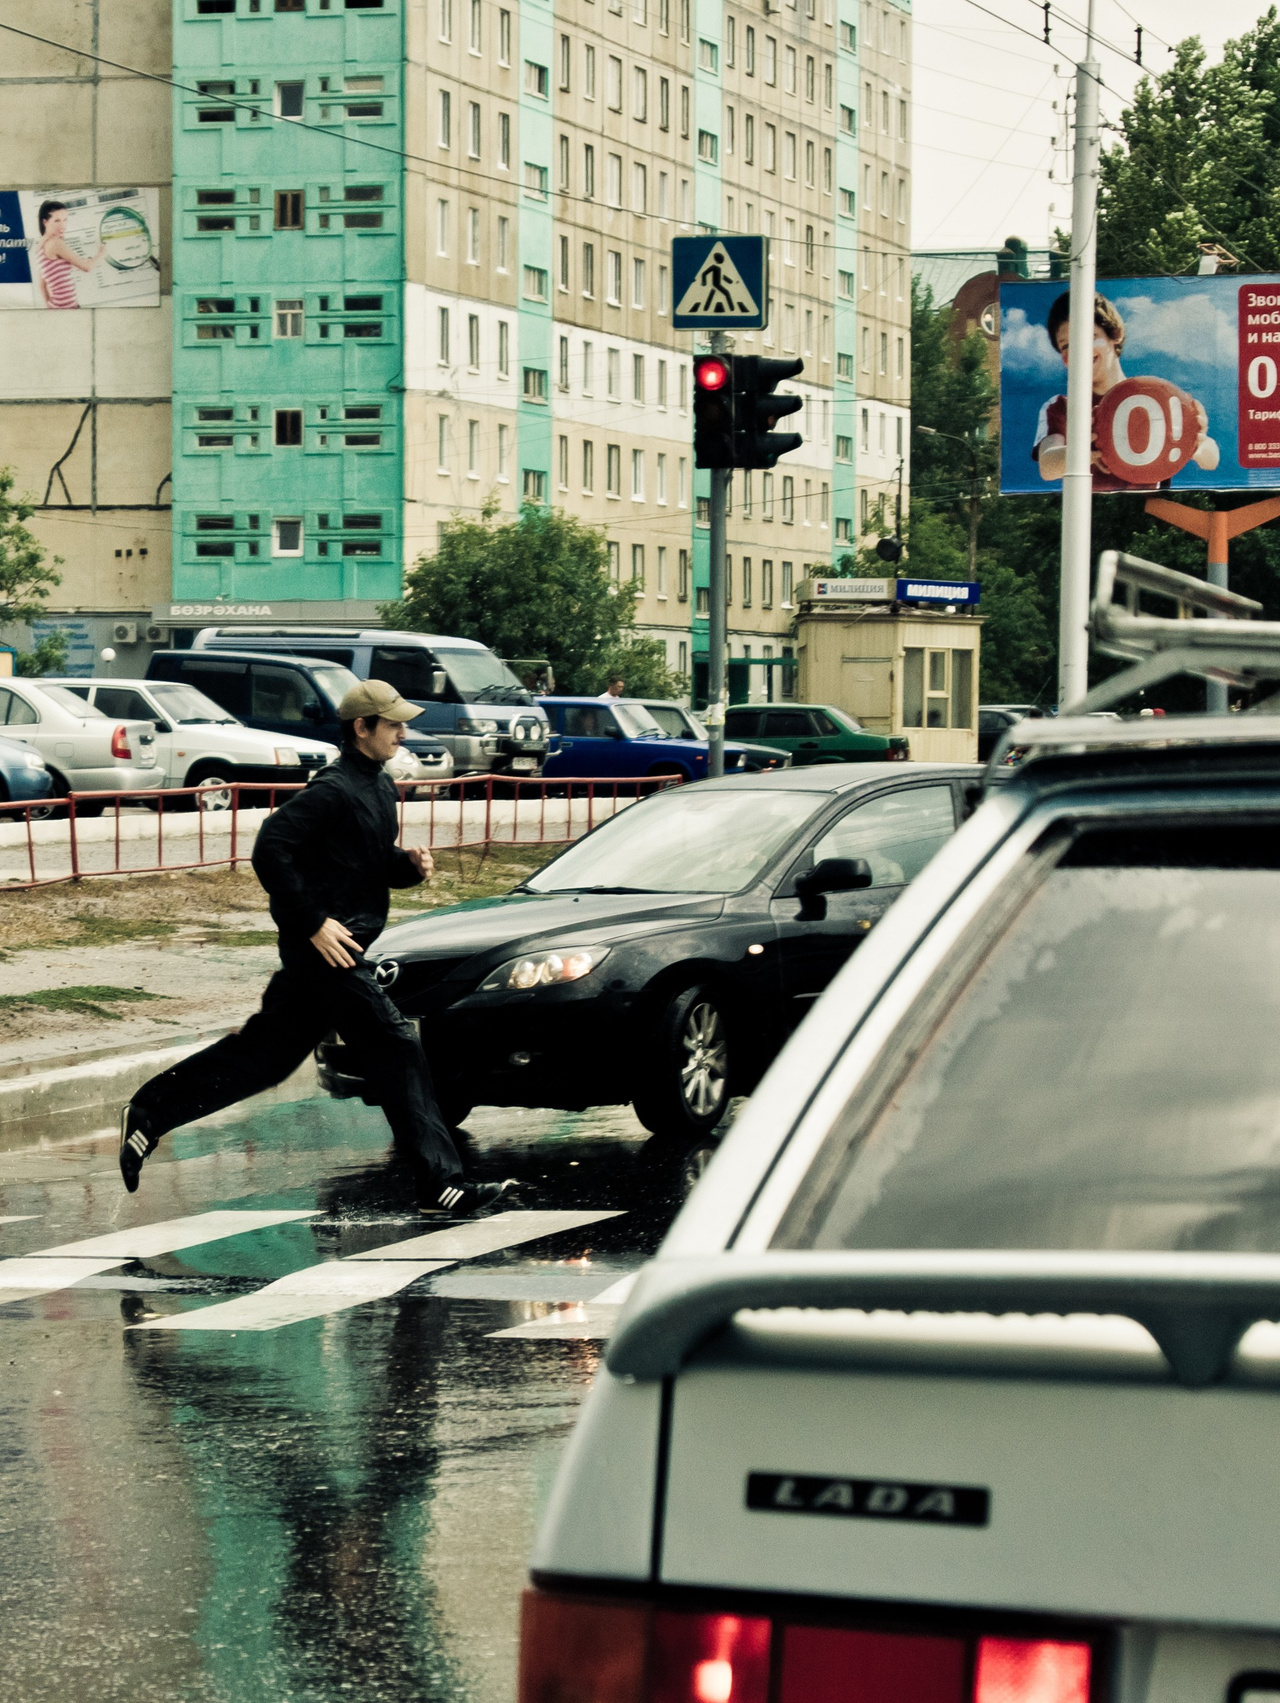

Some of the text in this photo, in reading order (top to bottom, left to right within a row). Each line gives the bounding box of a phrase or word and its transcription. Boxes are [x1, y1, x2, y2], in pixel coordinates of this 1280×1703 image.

[1247, 311, 1280, 325] моб
[1247, 333, 1258, 343] и
[830, 585, 885, 594] МИЛИЦИЯ
[907, 584, 969, 600] МИЛИЦИЯ
[774, 1479, 956, 1517] LADA
